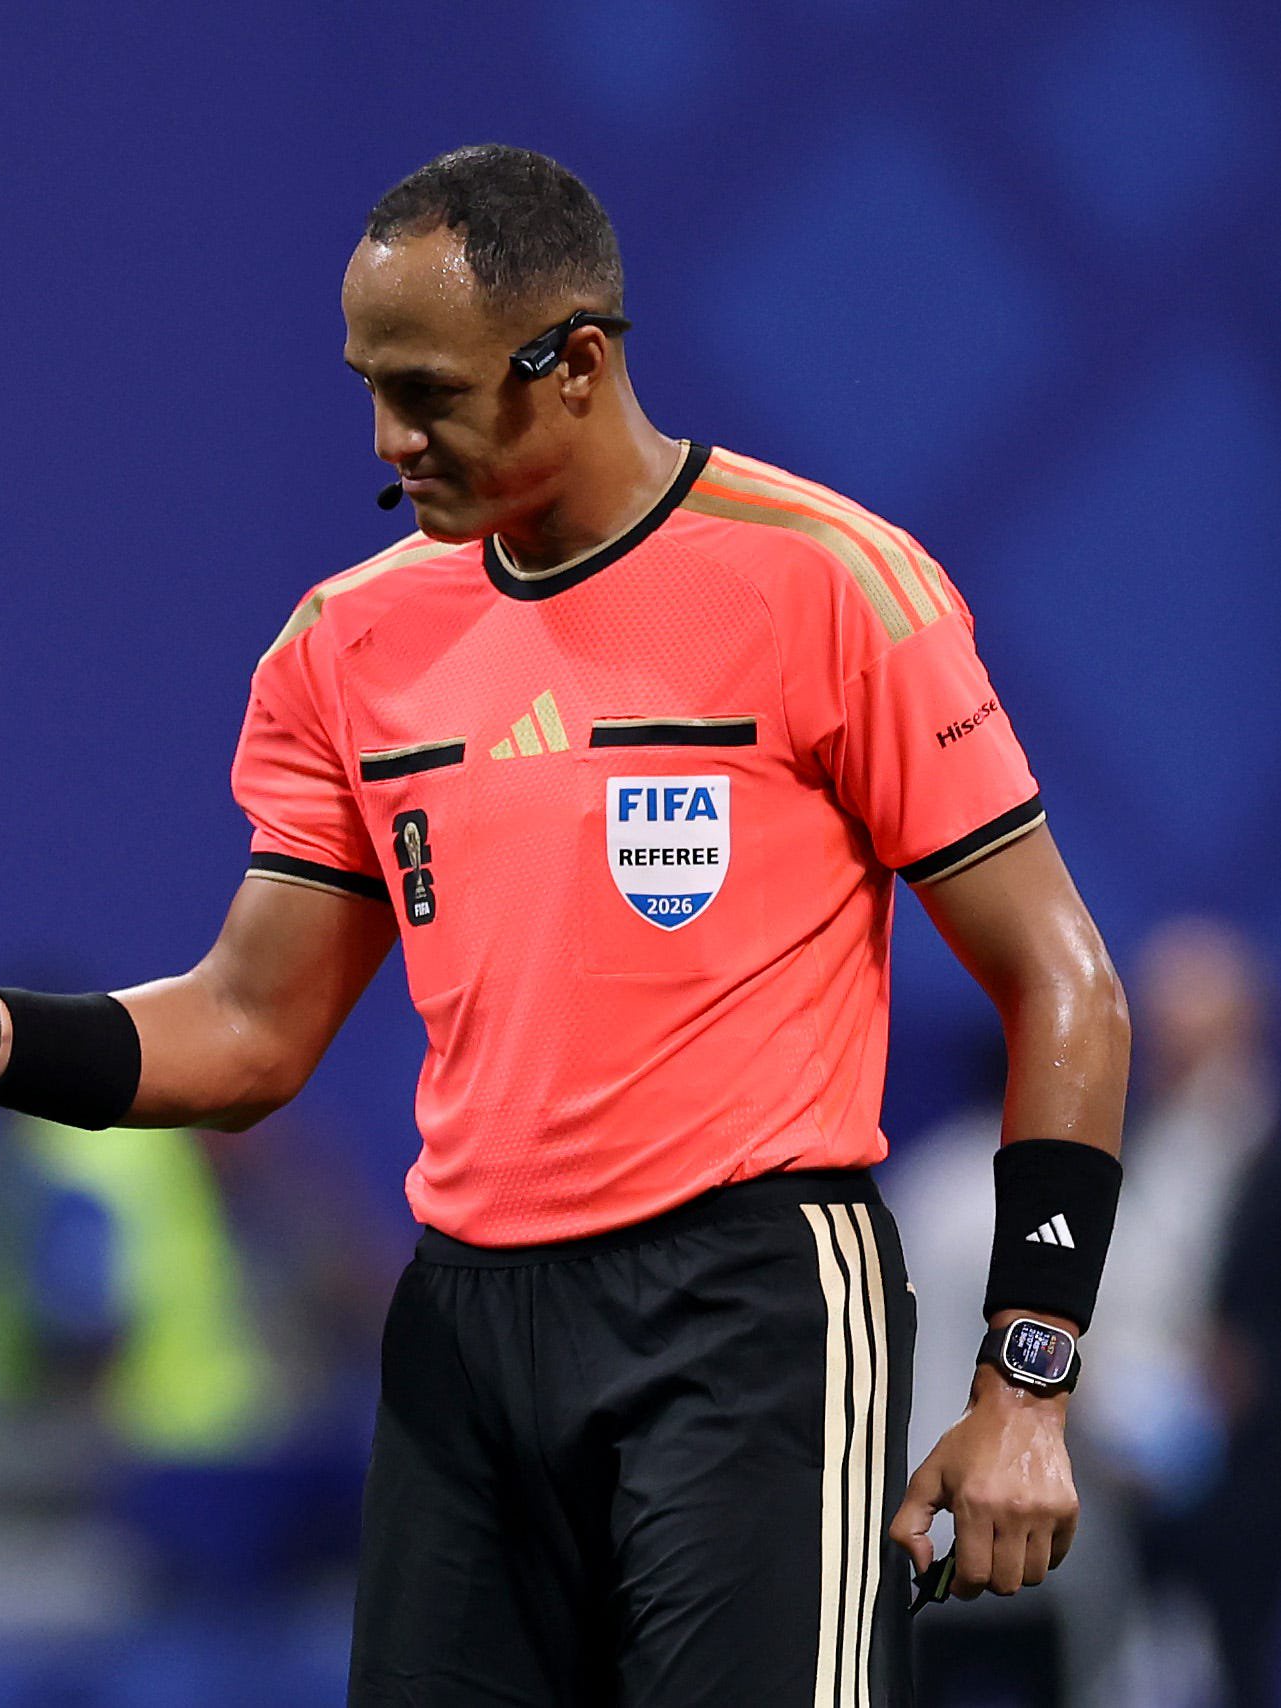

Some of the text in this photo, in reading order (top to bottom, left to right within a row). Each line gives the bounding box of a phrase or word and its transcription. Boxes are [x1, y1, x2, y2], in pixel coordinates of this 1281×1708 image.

[619, 787, 718, 822] FIFA
[619, 848, 719, 866] REFEREE
[414, 902, 431, 918] FIFA
[647, 898, 693, 915] 2026
